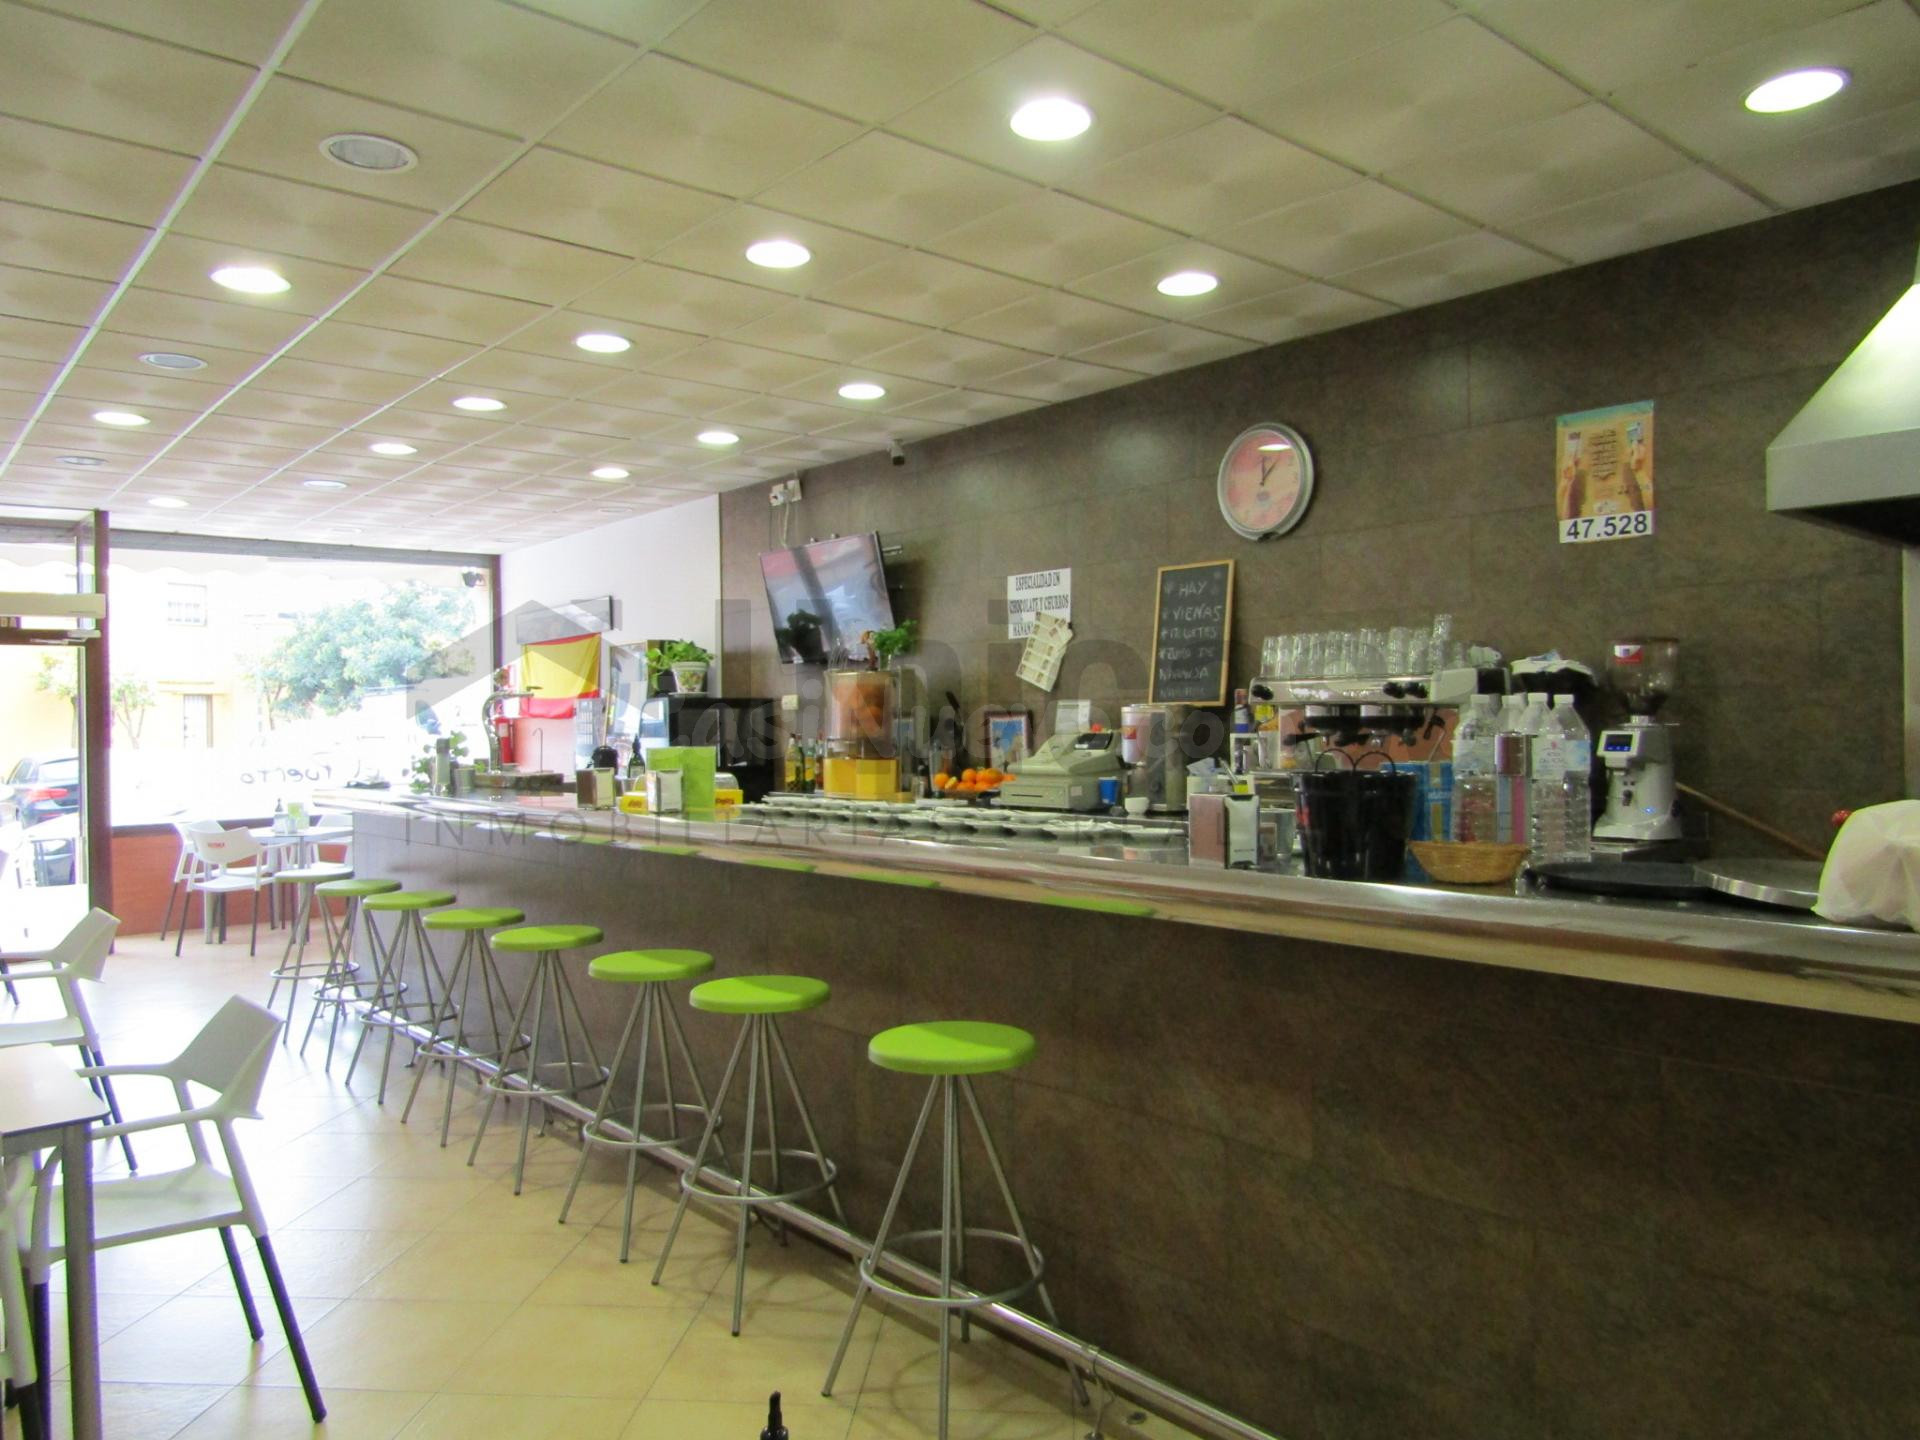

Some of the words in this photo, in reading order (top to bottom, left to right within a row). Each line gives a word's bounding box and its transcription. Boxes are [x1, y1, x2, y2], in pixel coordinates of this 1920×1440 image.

[1567, 513, 1648, 539] 47.528
[1015, 572, 1052, 591] ESPECIALIDAD
[1052, 571, 1061, 587] EN
[1179, 580, 1207, 597] HAY
[1009, 597, 1039, 614] CHOCOLATE
[1044, 594, 1069, 611] CHURROS
